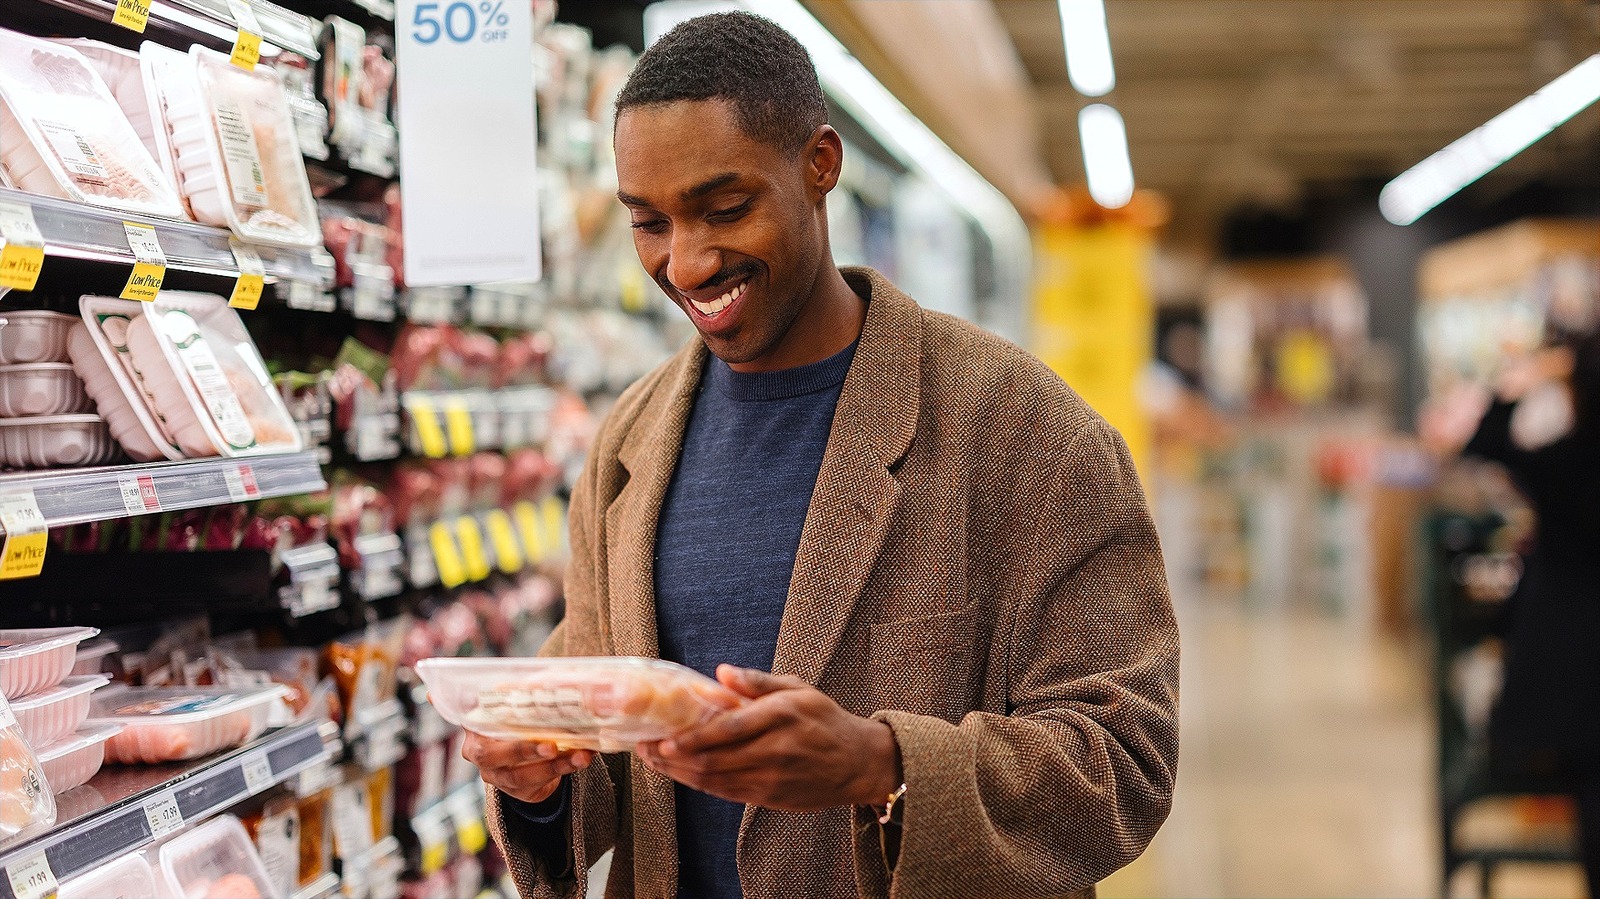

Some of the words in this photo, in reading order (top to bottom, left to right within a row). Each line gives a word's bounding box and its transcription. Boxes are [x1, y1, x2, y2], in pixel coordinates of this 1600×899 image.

[132, 0, 149, 16] Price
[483, 29, 508, 42] OFF
[131, 273, 145, 286] Low
[143, 274, 161, 288] Price
[162, 805, 178, 820] $7.99
[28, 871, 48, 887] $7.99
